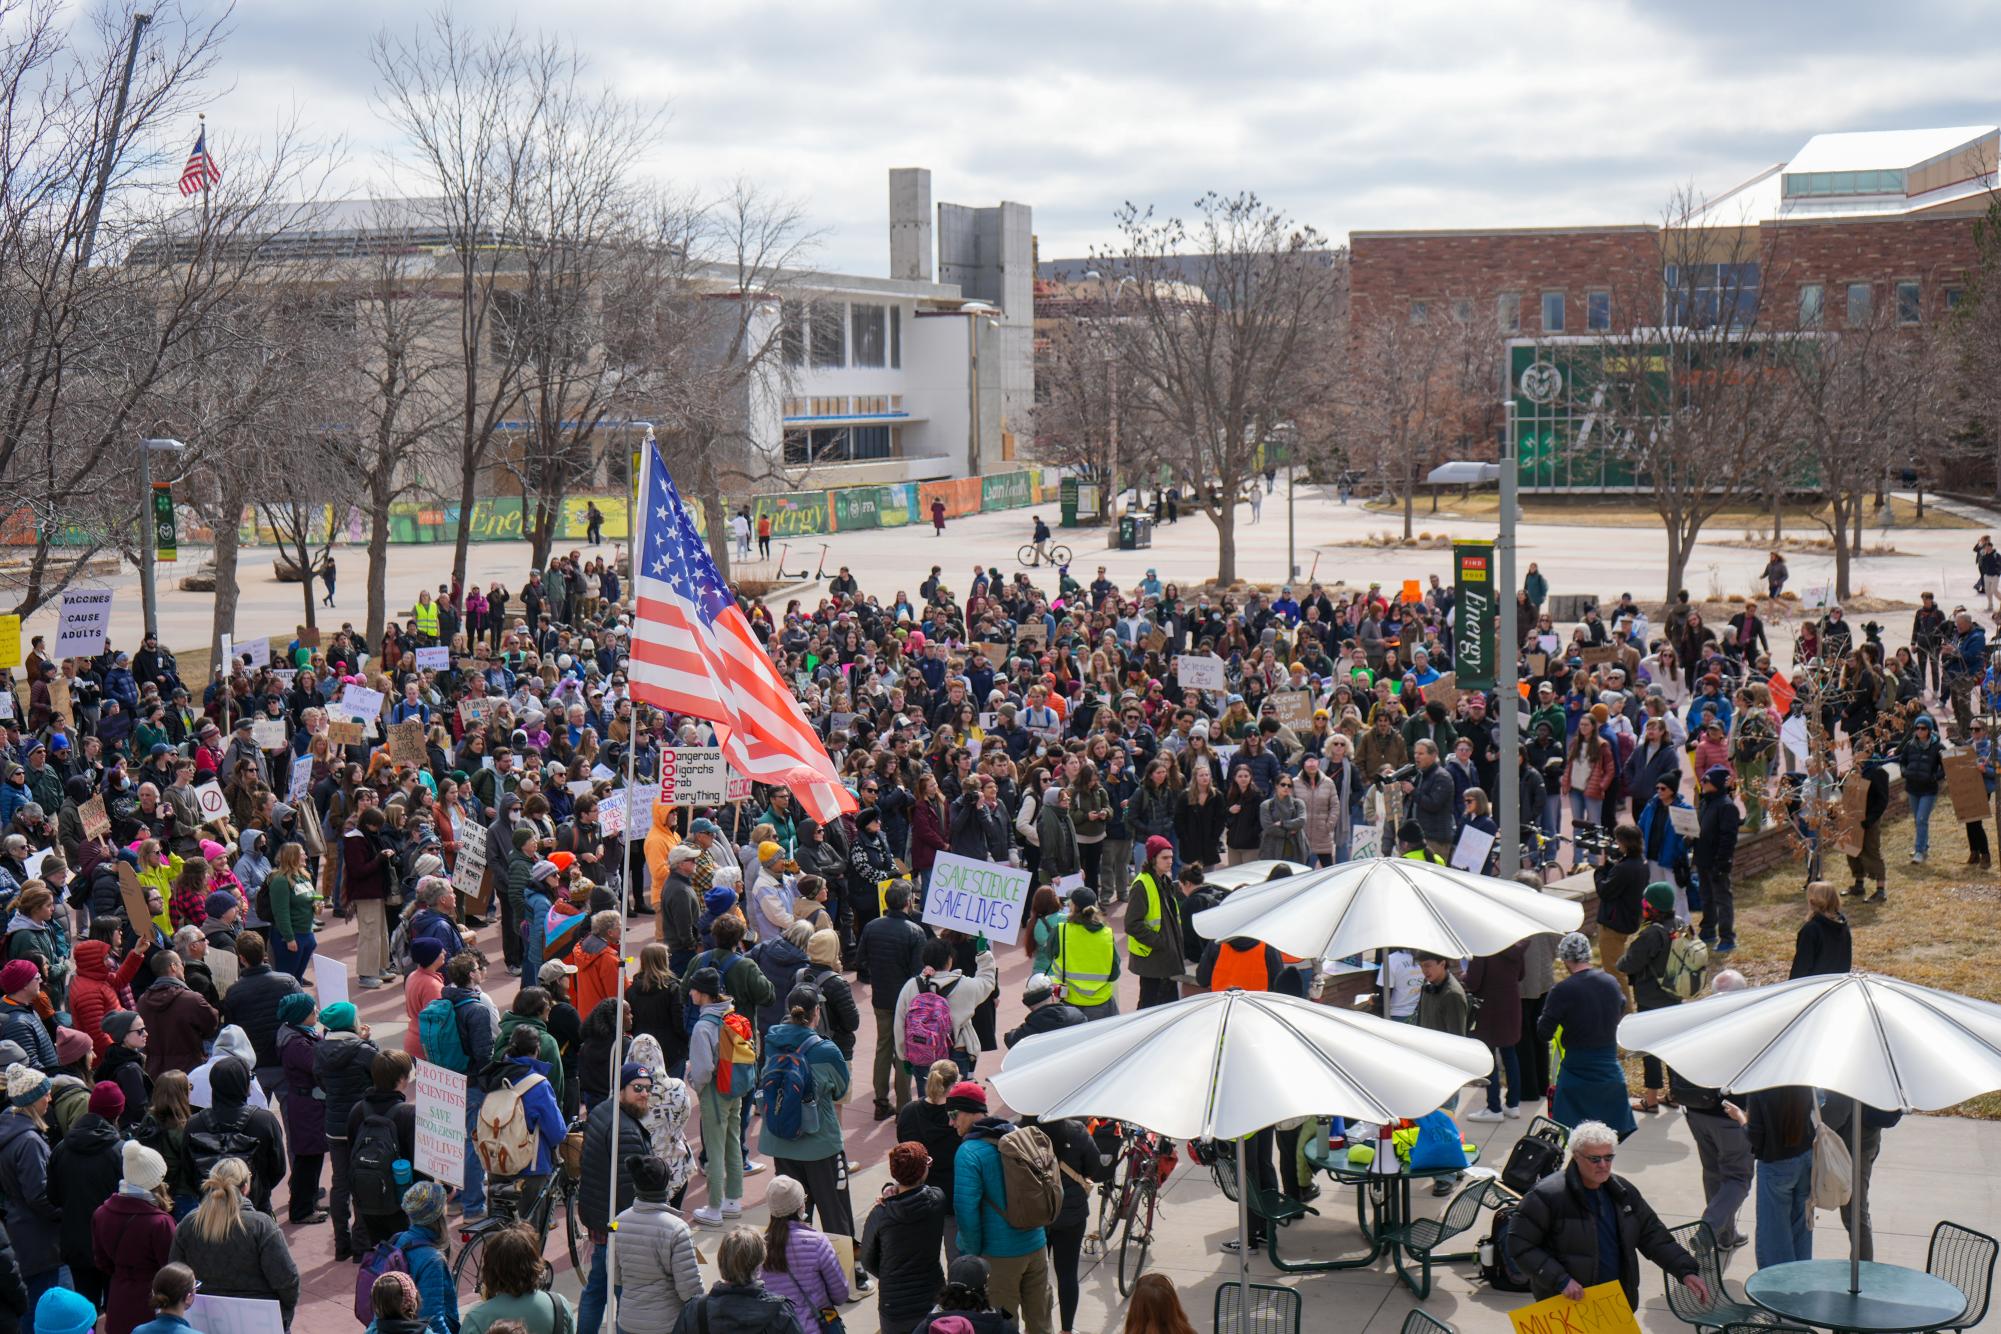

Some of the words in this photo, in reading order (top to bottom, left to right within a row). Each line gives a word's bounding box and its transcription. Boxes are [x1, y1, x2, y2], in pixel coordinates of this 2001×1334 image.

[64, 595, 110, 605] VACCINES
[68, 613, 100, 623] CAUSE
[61, 629, 102, 640] ADULTS
[1459, 588, 1488, 674] Energy
[663, 750, 720, 764] Dangerous
[662, 764, 714, 778] Oligarchs
[662, 778, 692, 790] Grab
[661, 790, 720, 804] Everything
[464, 820, 478, 832] WHEN
[462, 829, 476, 842] LAST
[935, 863, 972, 891] SAVE
[971, 868, 1025, 902] SCIENCE
[930, 888, 967, 919] SAVE
[966, 895, 1012, 930] LIVES
[416, 1062, 466, 1091] PROTECT
[416, 1080, 464, 1108] SCIENTISTS
[429, 1106, 452, 1123] SAVE
[436, 1139, 464, 1161] LIVES
